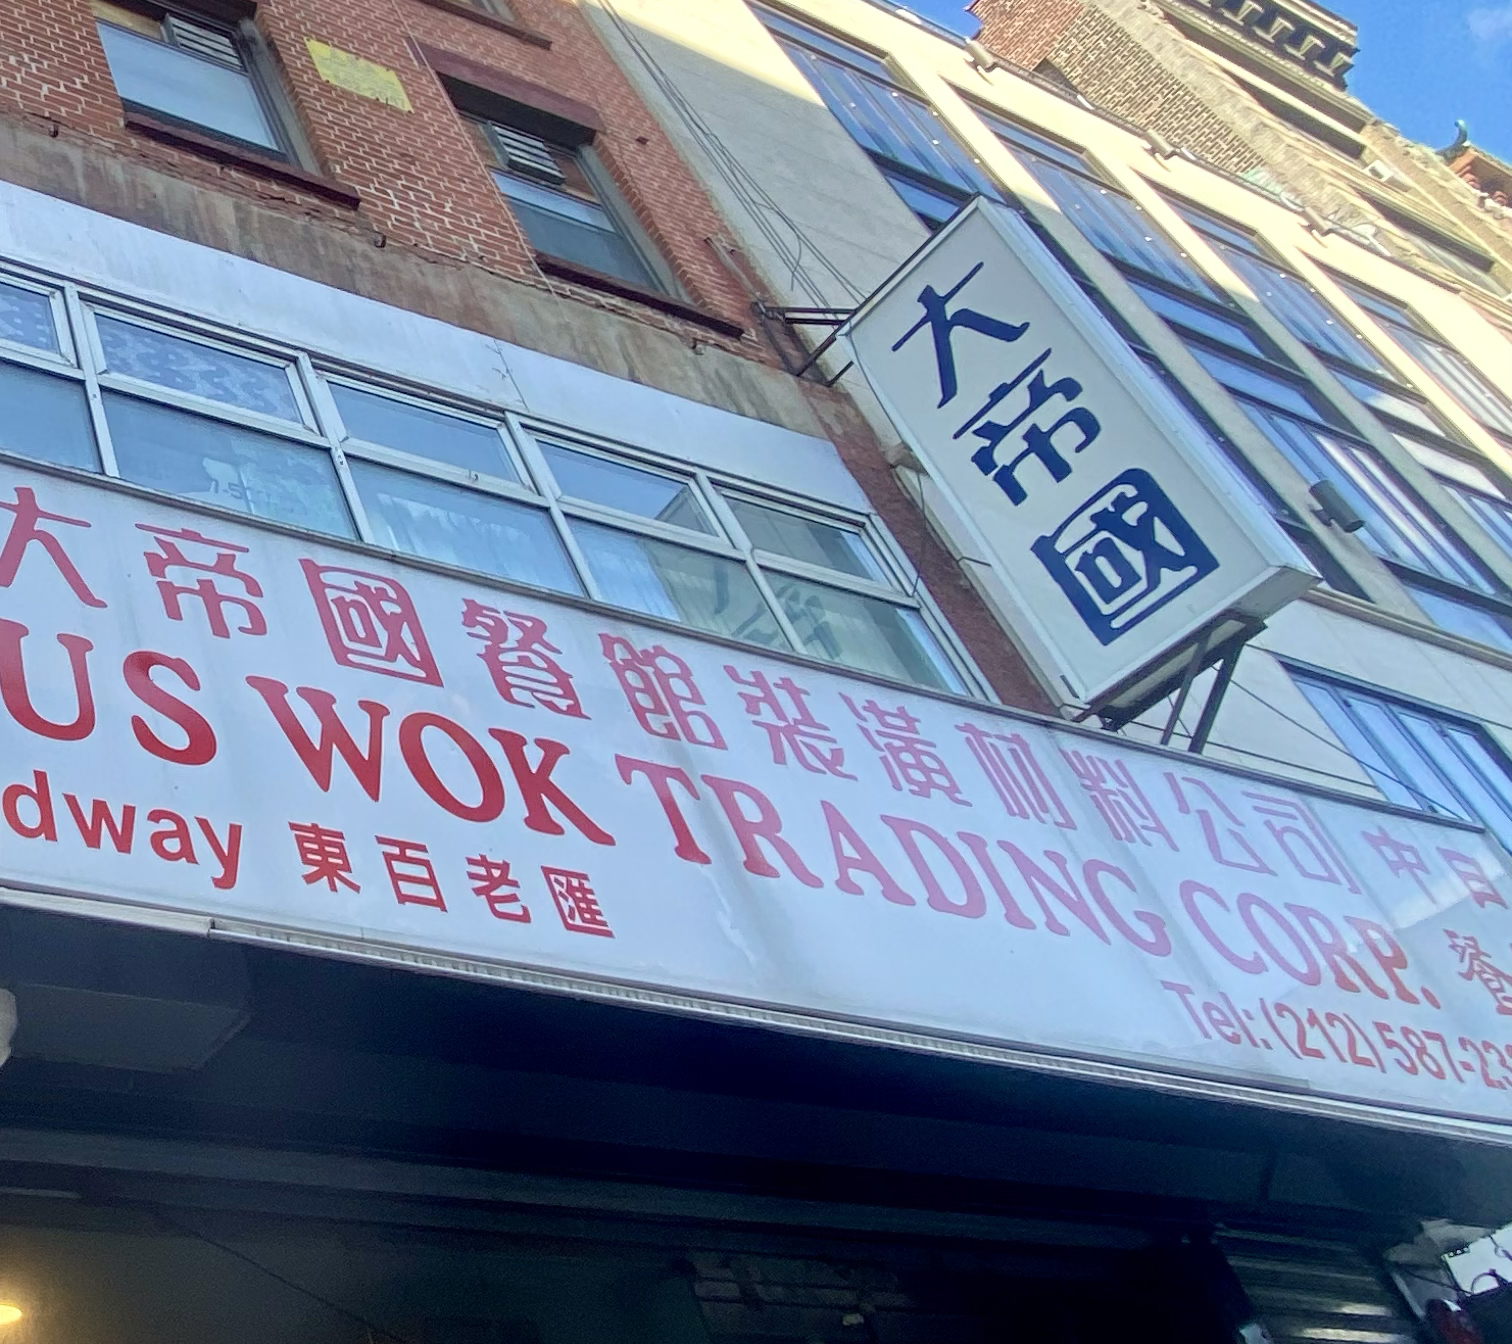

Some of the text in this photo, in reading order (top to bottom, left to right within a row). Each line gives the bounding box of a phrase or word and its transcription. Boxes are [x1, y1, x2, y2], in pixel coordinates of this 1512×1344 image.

[891, 261, 1220, 648] 大帝國
[245, 676, 615, 847] WOK
[614, 754, 1173, 958] TRADING
[1178, 880, 1441, 1011] CORP.
[288, 821, 615, 939] 東百老匯
